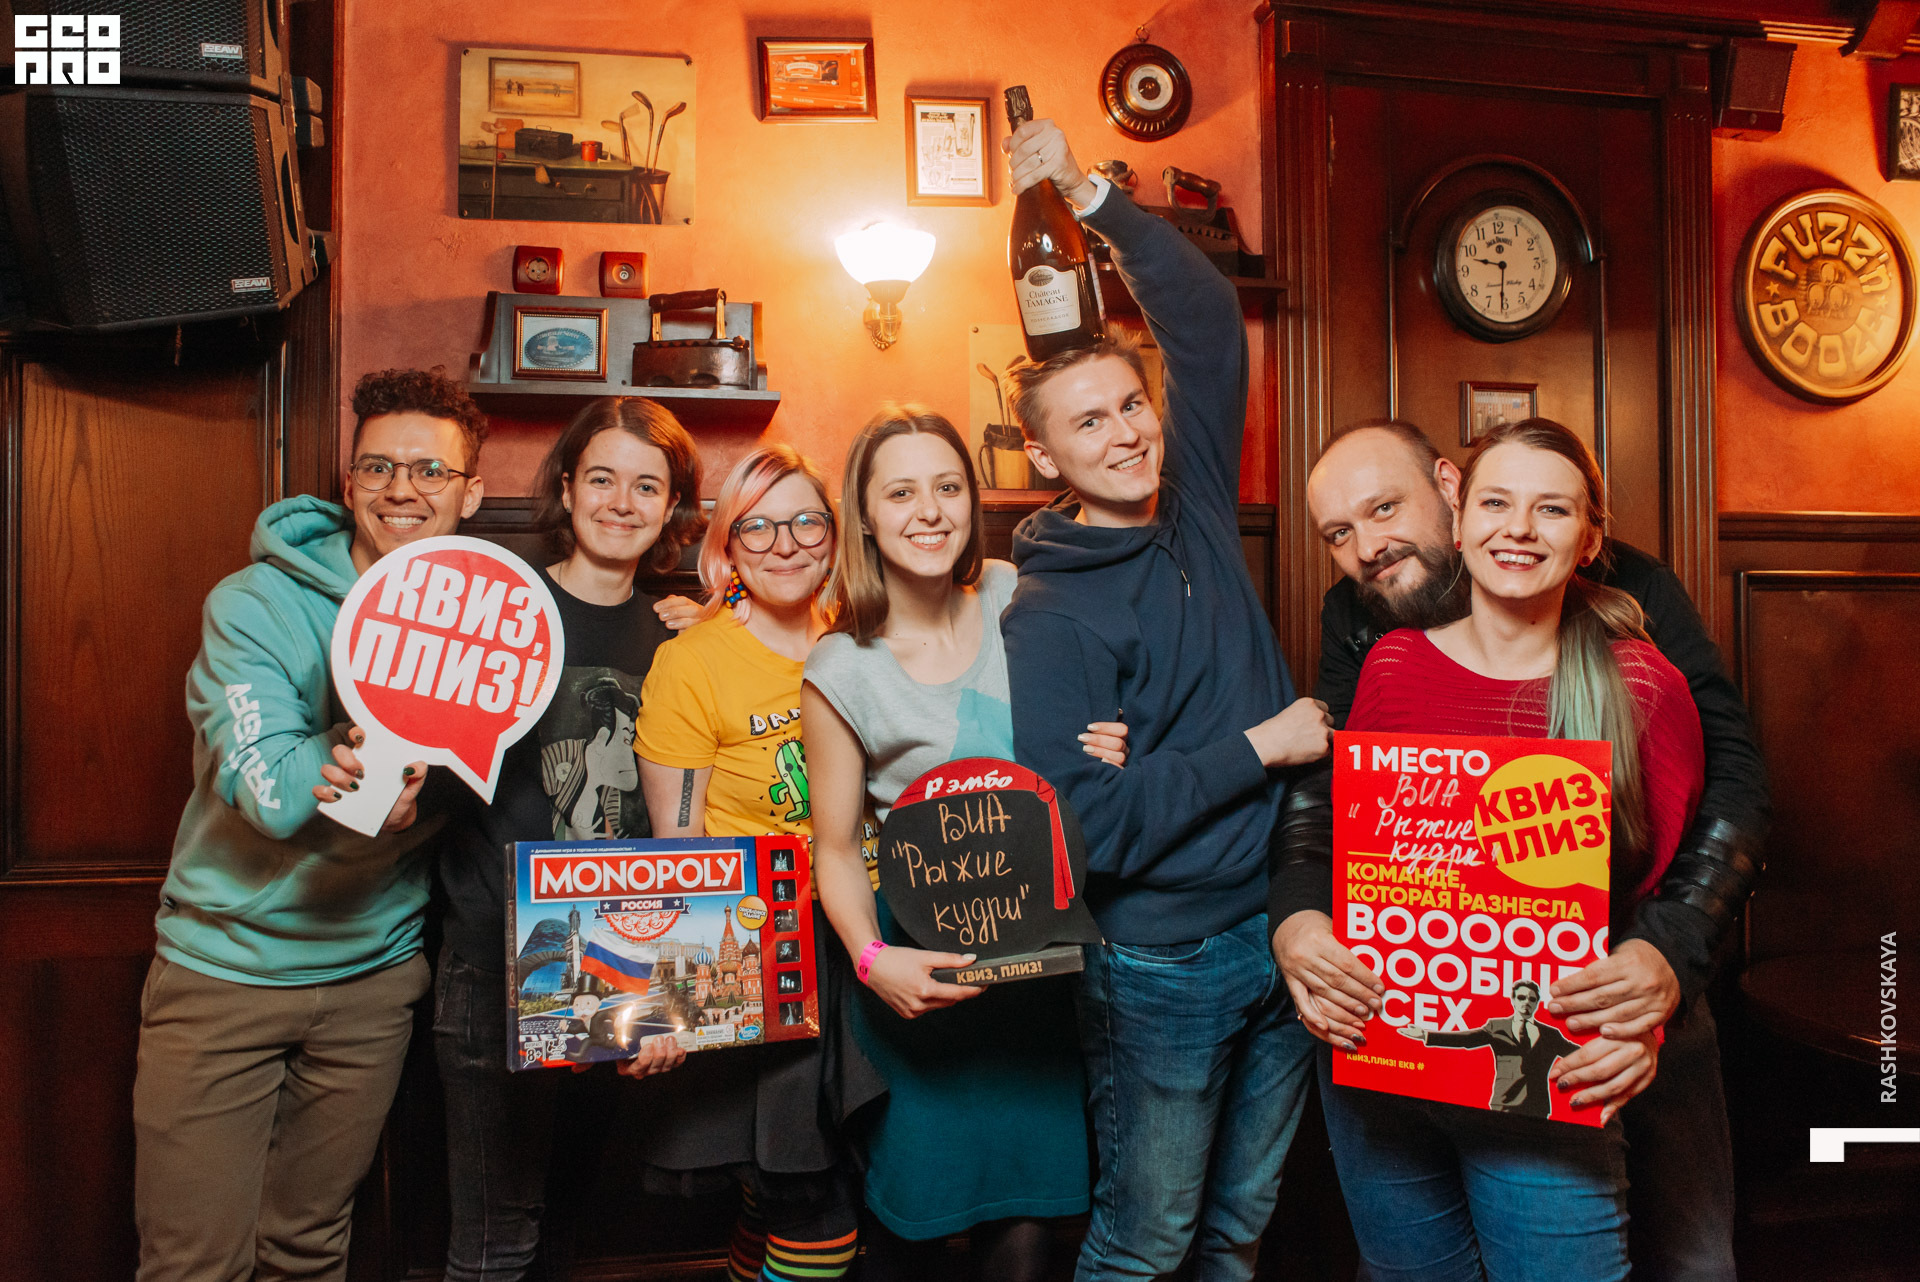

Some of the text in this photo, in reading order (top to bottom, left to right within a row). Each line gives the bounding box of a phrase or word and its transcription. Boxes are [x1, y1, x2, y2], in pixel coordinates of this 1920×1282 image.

[1476, 227, 1485, 240] 11
[1493, 221, 1504, 234] 12
[1514, 224, 1518, 237] 1
[1464, 244, 1477, 257] 10
[1527, 238, 1534, 251] 2
[1533, 257, 1541, 270] 3
[1461, 265, 1469, 278] 9
[1528, 278, 1536, 290] 4
[1470, 285, 1478, 297] 8
[1026, 295, 1068, 308] TAMAGNE
[1486, 296, 1492, 308] 7
[1502, 297, 1509, 310] 6
[1518, 292, 1525, 304] 5
[1758, 300, 1897, 377] BOOZE
[376, 559, 544, 656] КВИЗ,
[350, 618, 544, 718] ПЛИЗ!
[1348, 745, 1491, 777] 1 МЕСТО
[1377, 773, 1461, 809] ВИА
[938, 793, 1012, 844] ВИА
[539, 856, 738, 894] MONOPOLY
[1347, 862, 1467, 892] КОМАНДЕ,
[620, 900, 663, 911] РОССИЯ
[1347, 883, 1585, 921] КОТОРАЯ РАЗНЕСЛА
[956, 960, 1043, 984] КВИЗ, ПЛИЗ!
[1363, 989, 1473, 1032] СЕХ
[527, 1048, 543, 1062] 8+
